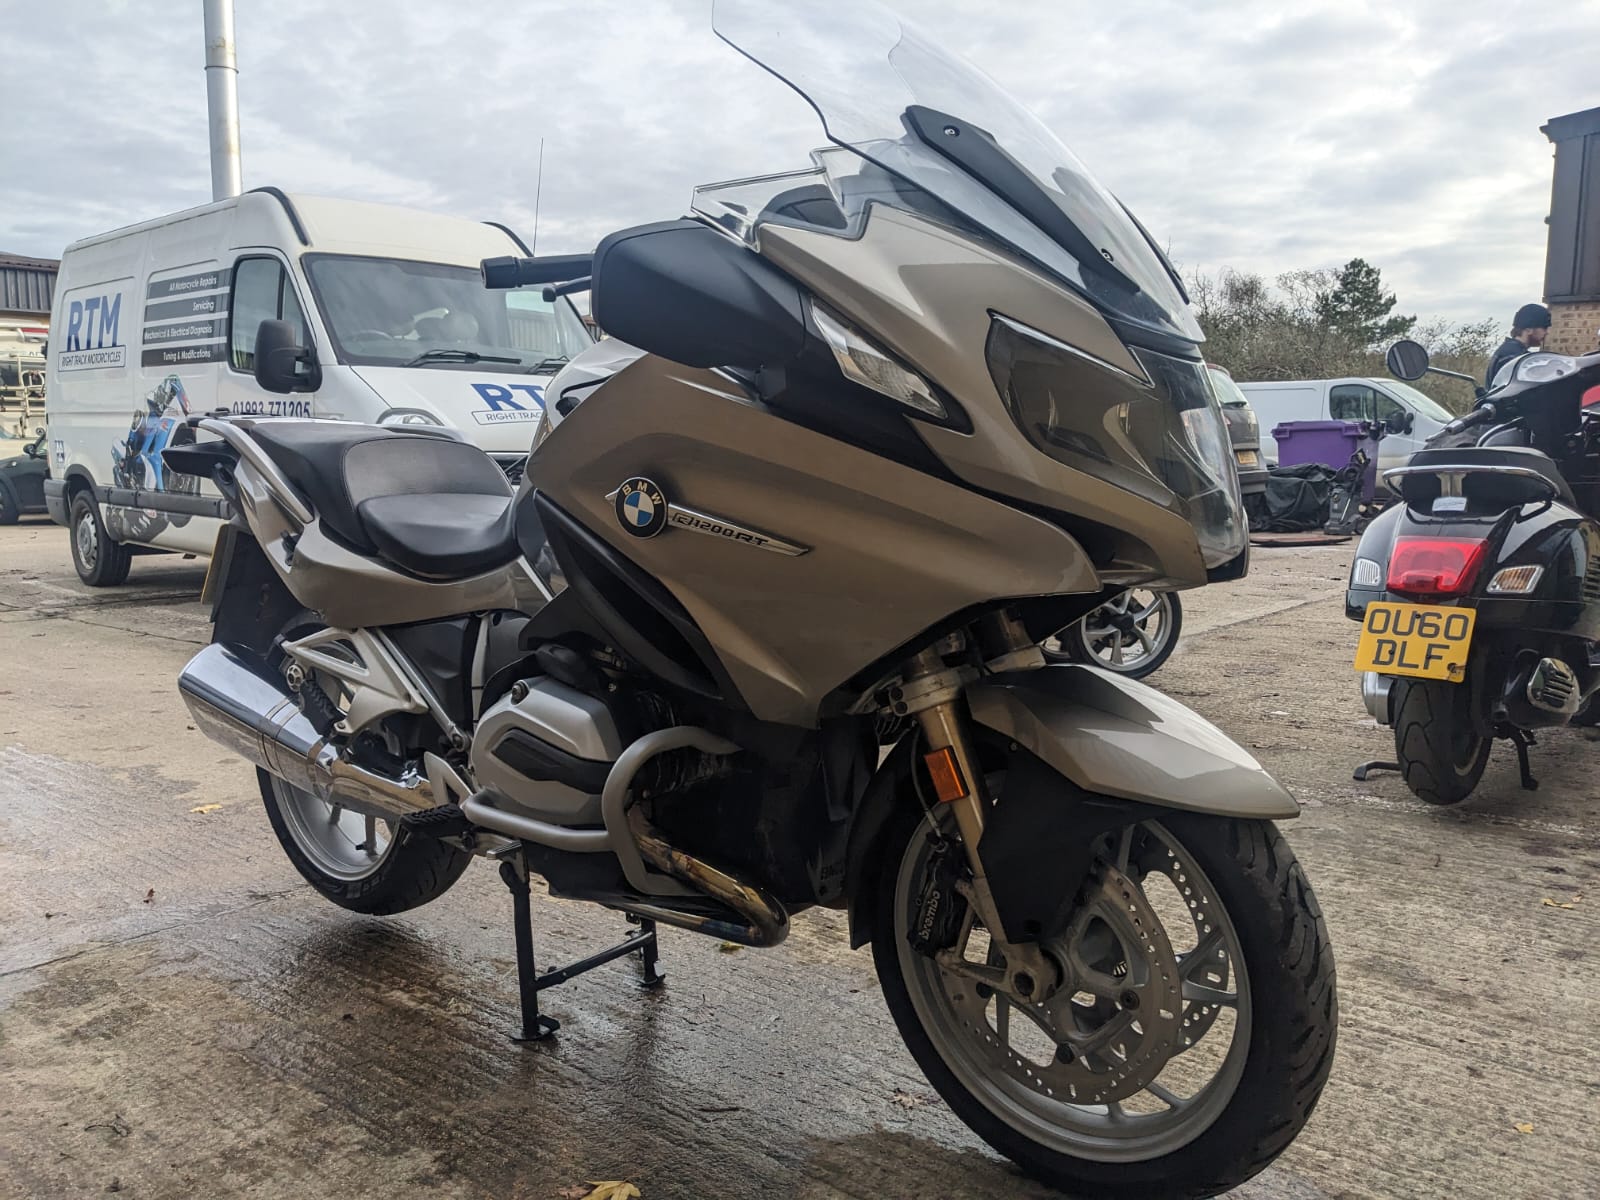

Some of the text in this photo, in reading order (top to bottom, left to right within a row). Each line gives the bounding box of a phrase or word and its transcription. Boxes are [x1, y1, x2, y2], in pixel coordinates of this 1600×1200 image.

[200, 276, 217, 288] Repairs
[193, 301, 215, 312] Servicing
[66, 293, 122, 352] RTM
[170, 326, 190, 337] Electrical
[190, 324, 213, 336] Diagnosis
[62, 351, 122, 367] RIGHT TRACK MOTORCYCLES
[163, 351, 177, 362] Tuning
[181, 348, 211, 360] Modifications
[470, 383, 545, 411] RT
[233, 401, 311, 418] 01993 771205
[486, 411, 541, 421] RIGHT TRAC
[622, 480, 662, 507] BMW
[1367, 608, 1470, 642] OU60
[1371, 638, 1451, 671] DLF
[919, 890, 941, 941] brembo
